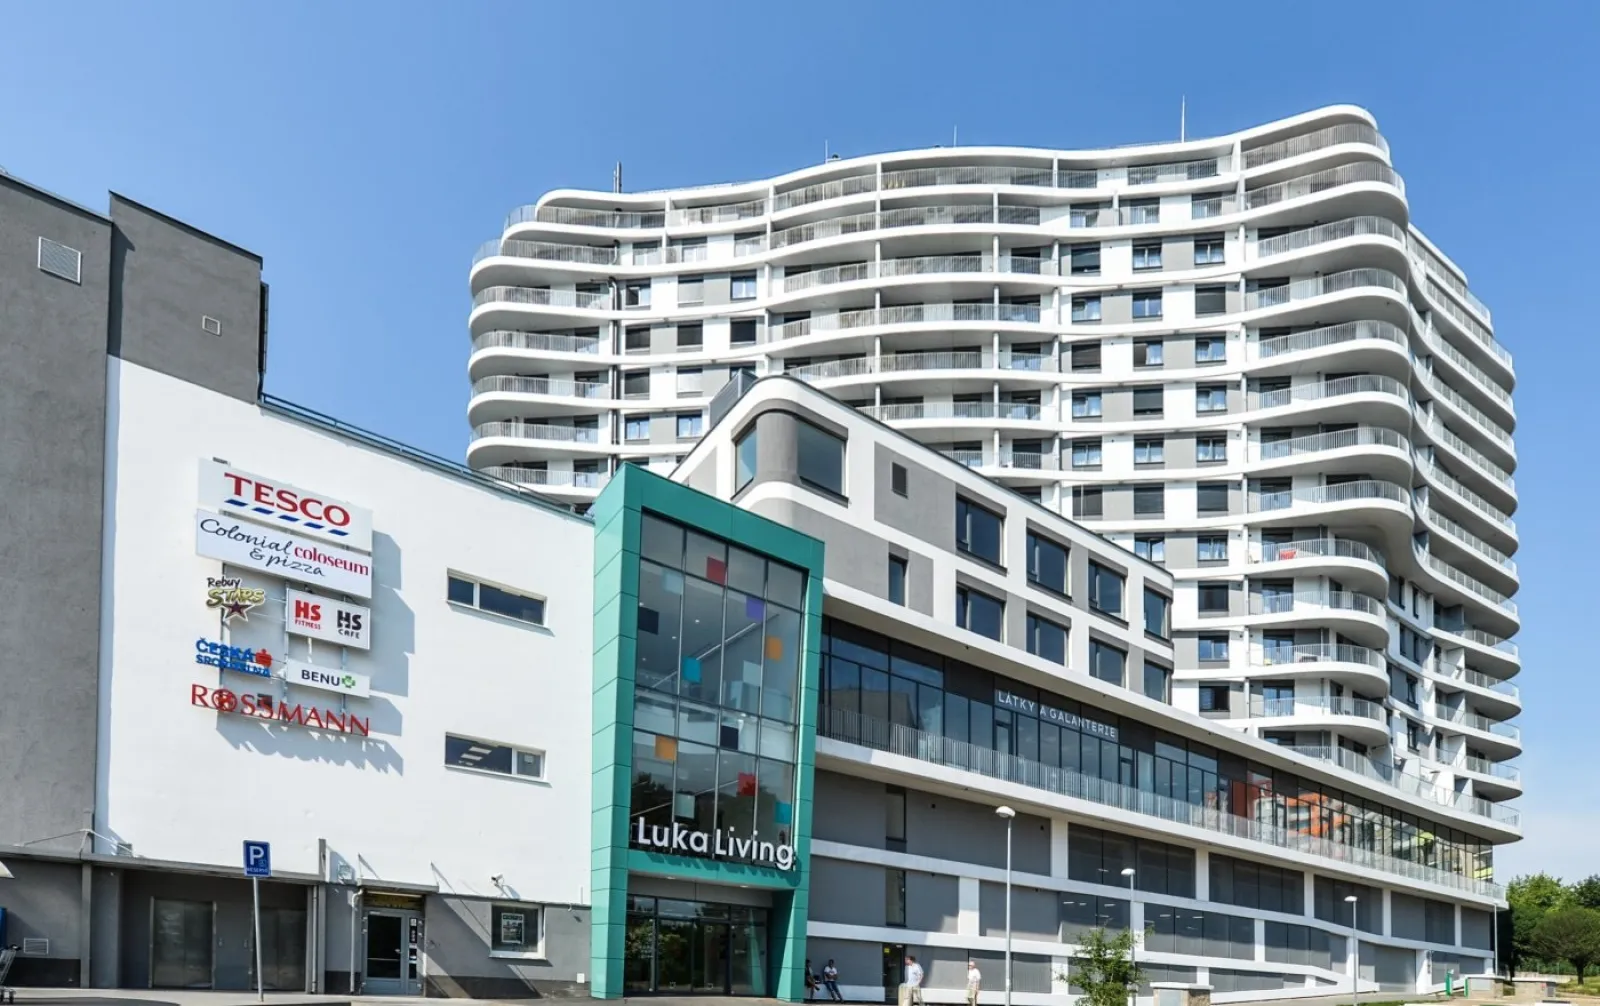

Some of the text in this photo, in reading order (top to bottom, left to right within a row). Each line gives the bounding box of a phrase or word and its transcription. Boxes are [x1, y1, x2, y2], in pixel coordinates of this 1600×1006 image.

[224, 472, 350, 527] TESCO
[200, 518, 369, 576] Colonial coloseum
[249, 547, 326, 577] & pizza
[207, 577, 241, 589] Rebuy
[206, 588, 265, 608] STARS
[295, 600, 321, 622] HS
[337, 610, 362, 631] HS
[294, 619, 321, 630] FITNESS
[301, 669, 340, 686] BENU
[191, 683, 369, 737] ROSSMANN
[998, 690, 1116, 738] LÁTKY A GALANTERIE
[637, 815, 795, 871] Luka Living
[249, 845, 264, 866] P
